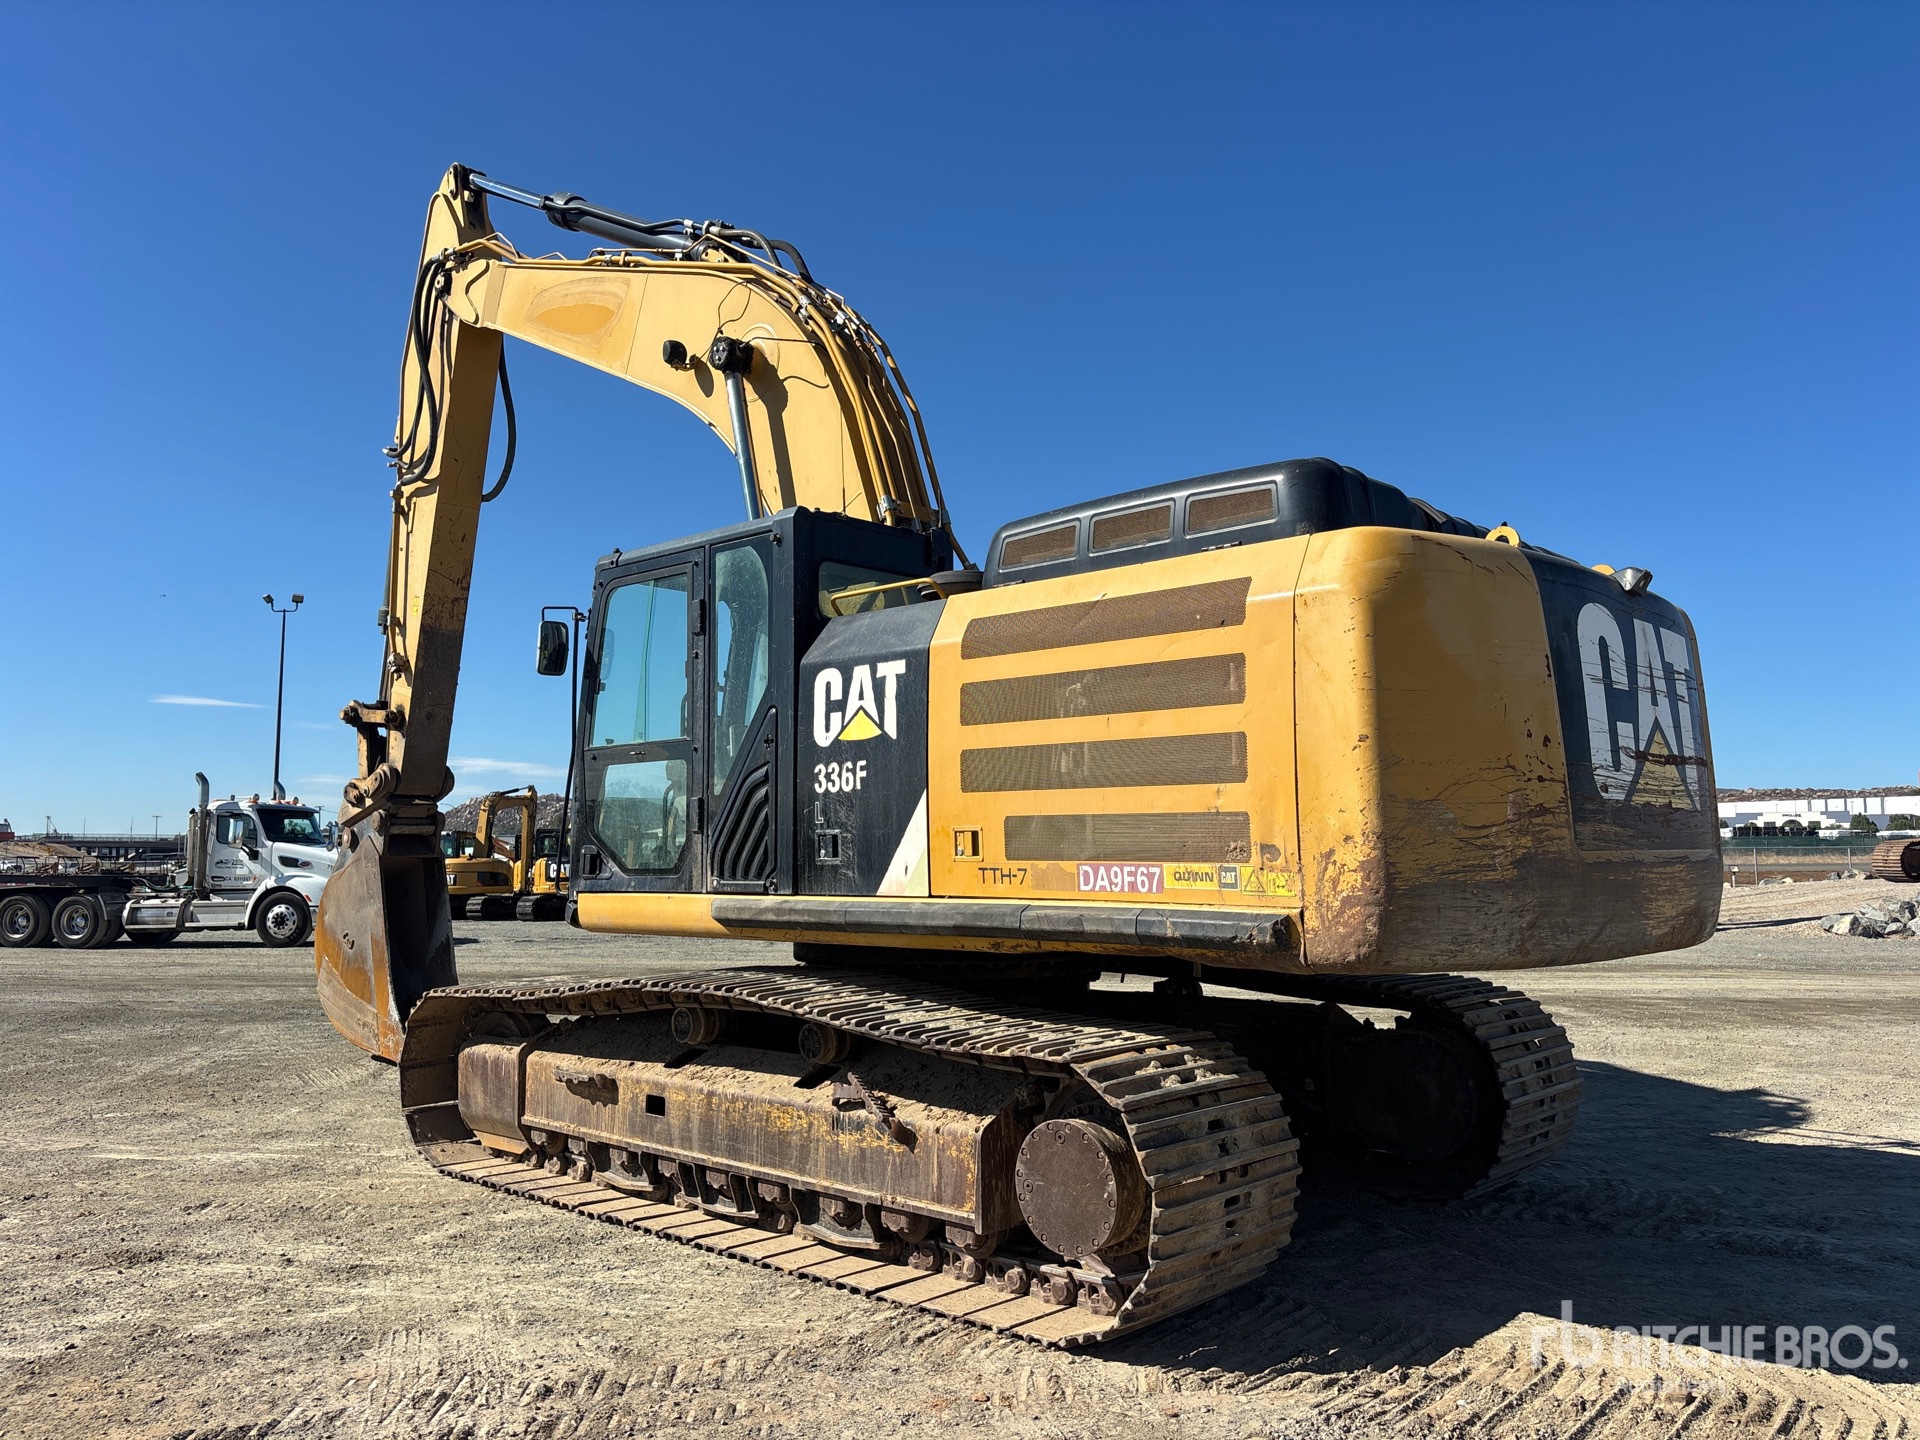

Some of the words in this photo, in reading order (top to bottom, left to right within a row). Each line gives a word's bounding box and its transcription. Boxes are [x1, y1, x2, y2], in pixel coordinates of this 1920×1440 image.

[813, 659, 906, 748] CAT
[1577, 602, 1701, 812] CAT
[814, 760, 867, 793] 336F
[978, 867, 1027, 885] TTH-7
[1080, 865, 1162, 894] DA9F67
[1173, 871, 1214, 883] QUINN
[1221, 871, 1236, 884] CAT
